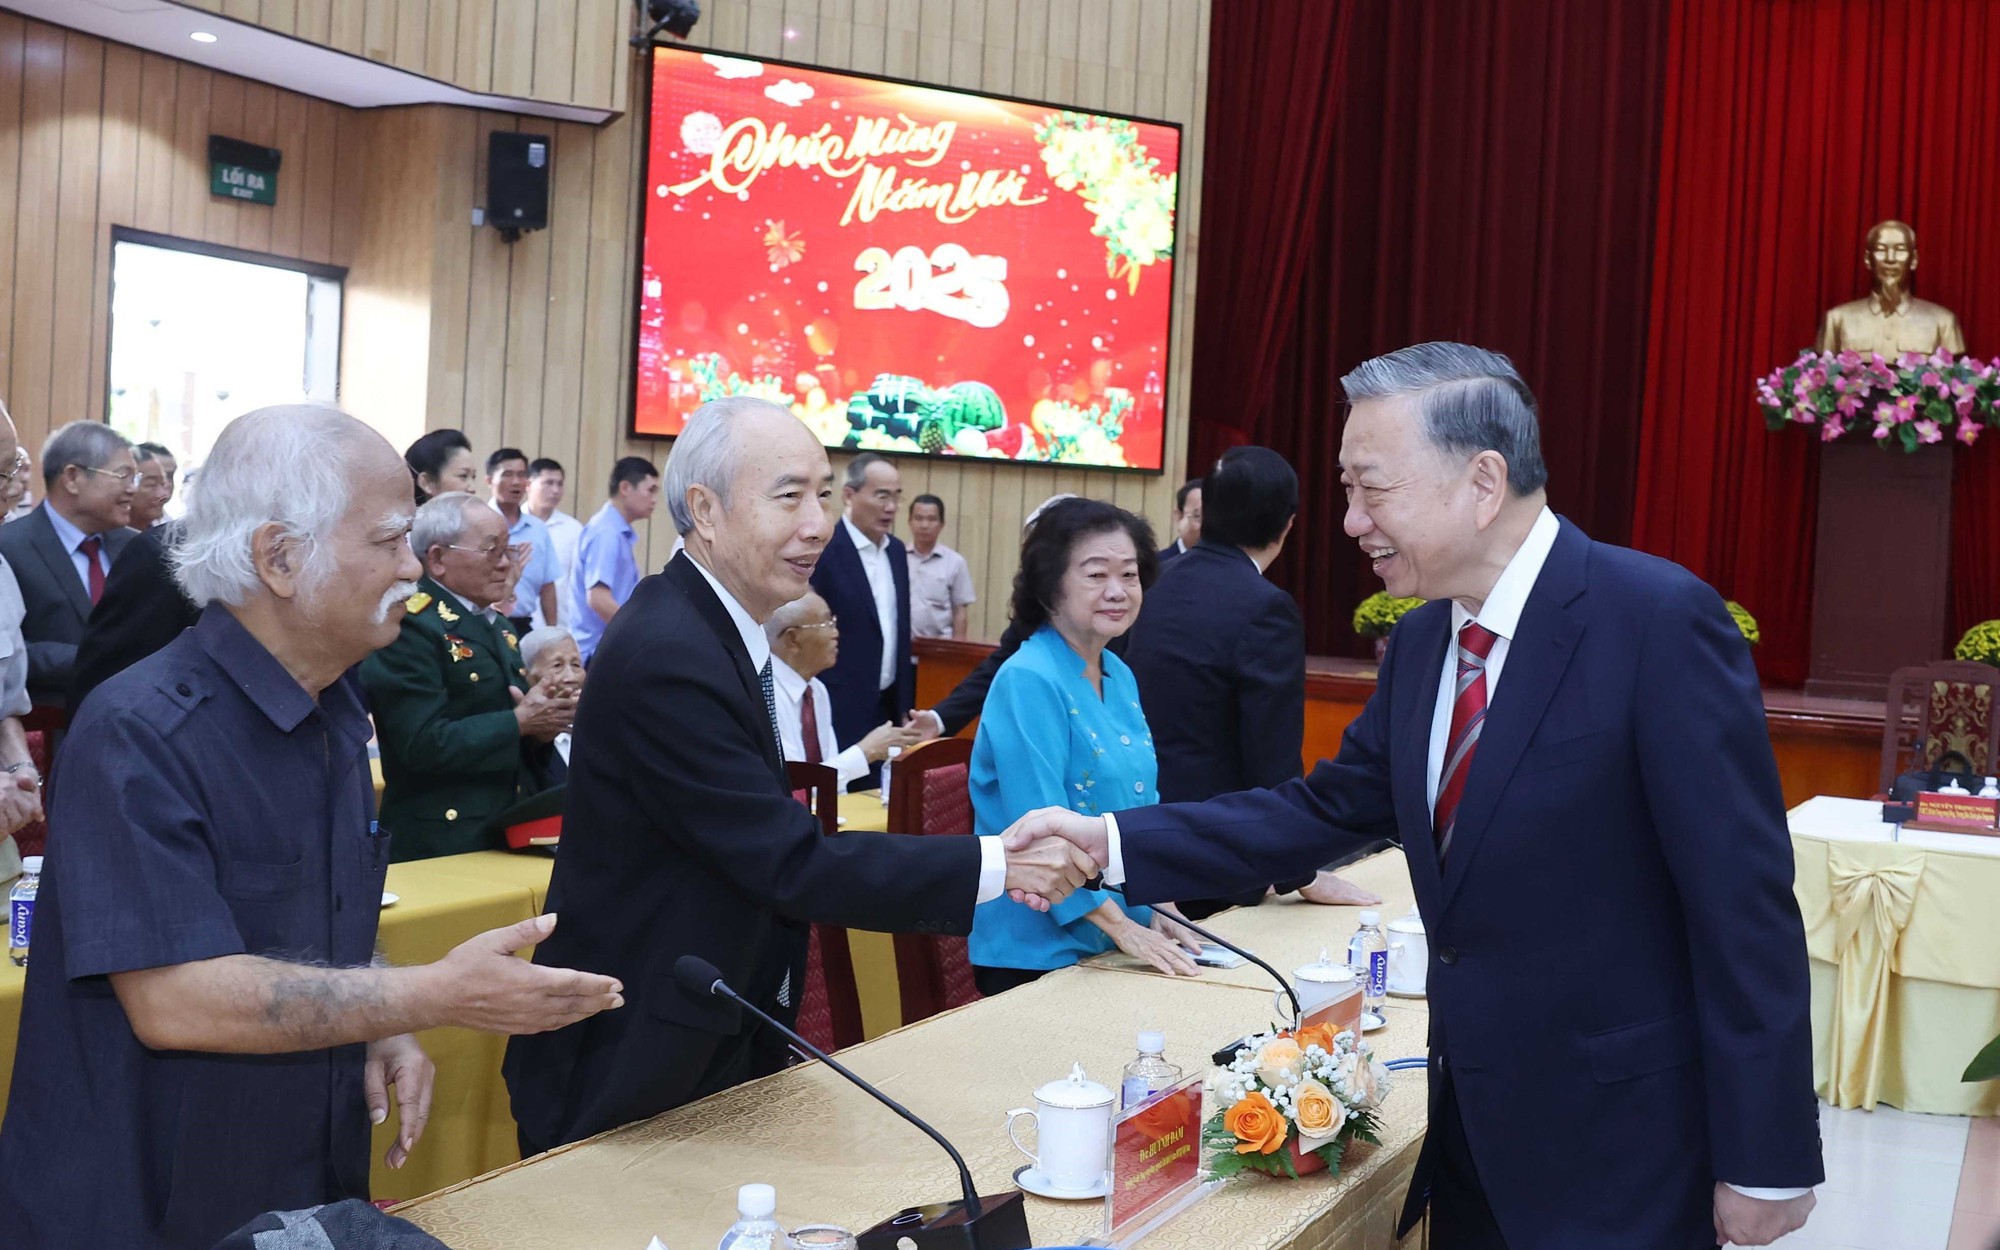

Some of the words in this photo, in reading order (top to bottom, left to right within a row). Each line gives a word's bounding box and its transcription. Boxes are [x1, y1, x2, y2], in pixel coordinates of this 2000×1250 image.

[247, 173, 265, 191] RA
[668, 117, 867, 196] Chúc
[839, 163, 978, 225] Năm
[853, 243, 1011, 329] 2025
[15, 902, 30, 946] Ocany
[1374, 954, 1386, 995] Ocany
